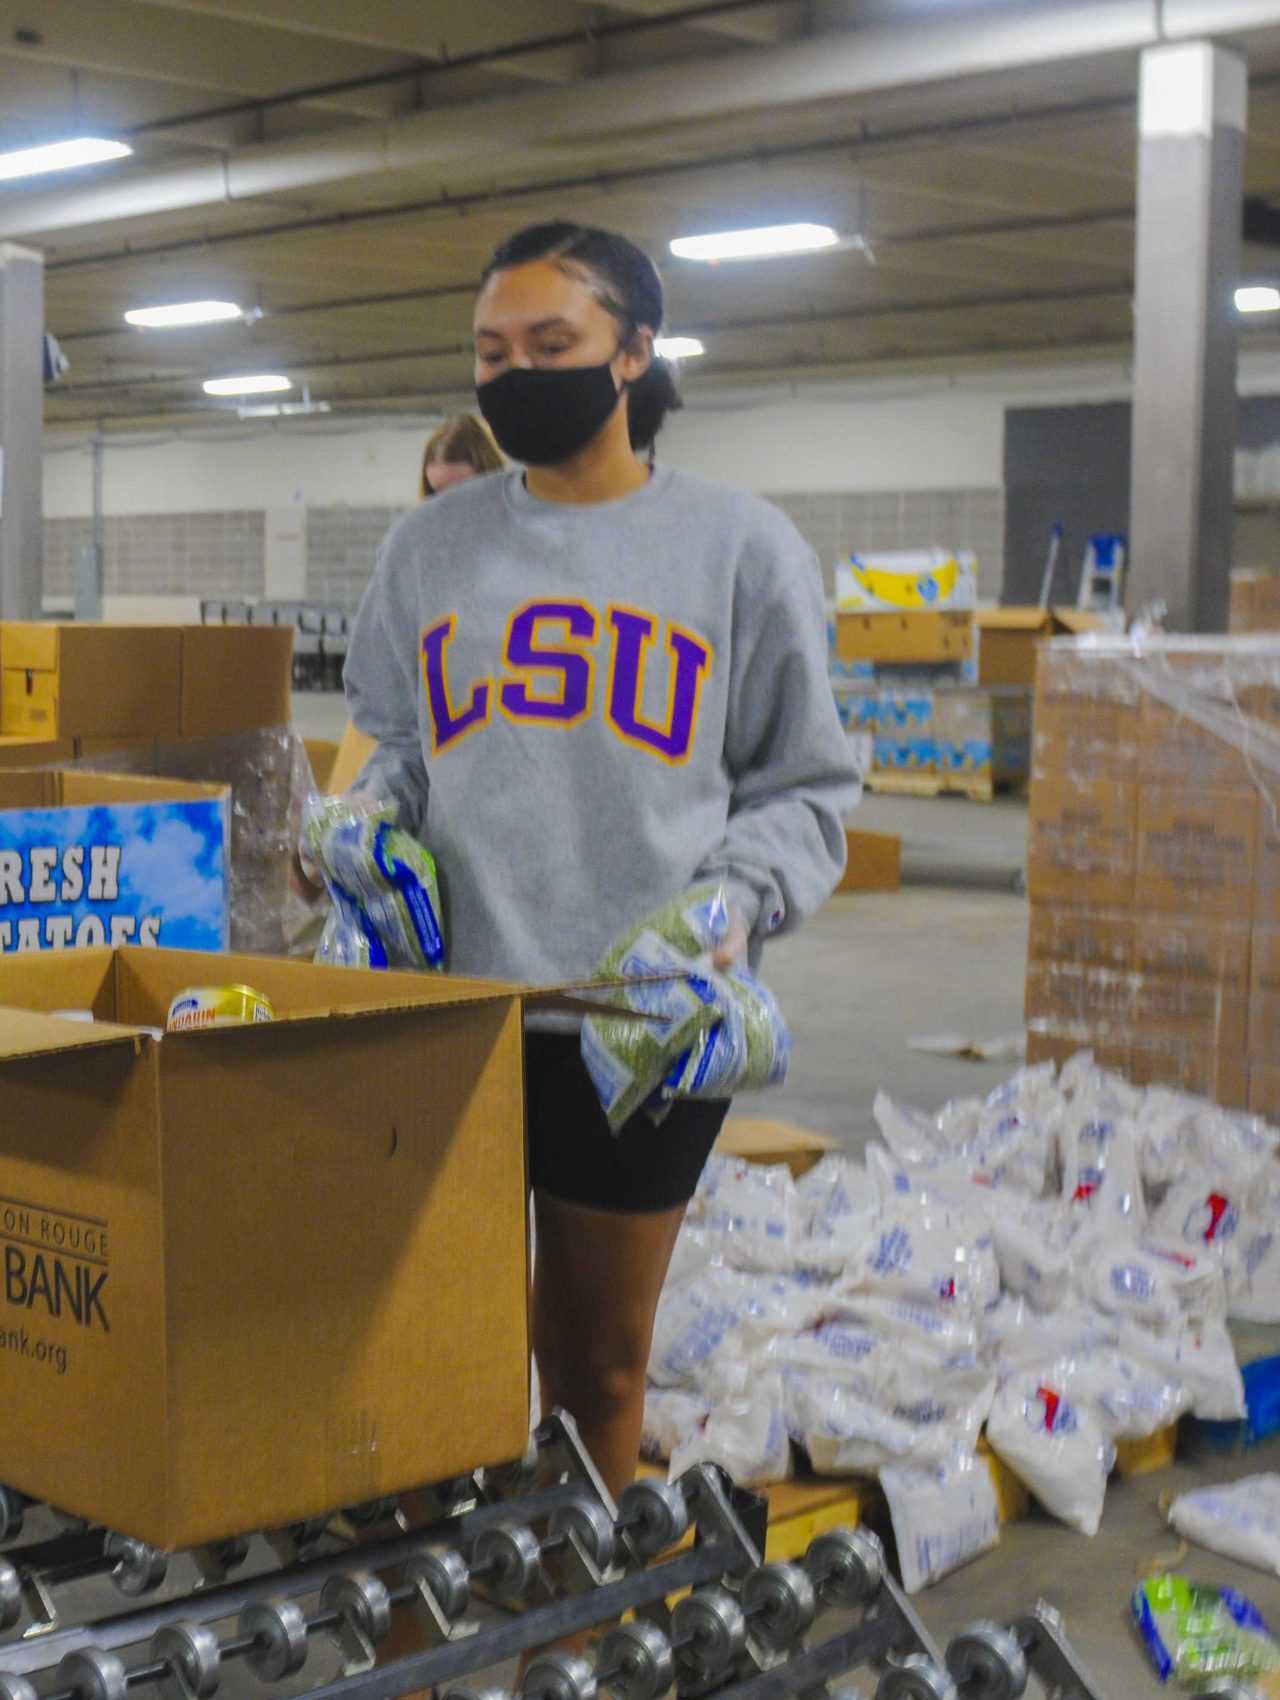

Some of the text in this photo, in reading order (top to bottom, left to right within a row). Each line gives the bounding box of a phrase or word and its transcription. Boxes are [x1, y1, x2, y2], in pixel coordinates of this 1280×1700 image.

[417, 597, 714, 766] LSU
[40, 1217, 109, 1257] ROUGE
[4, 1246, 111, 1334] BANK
